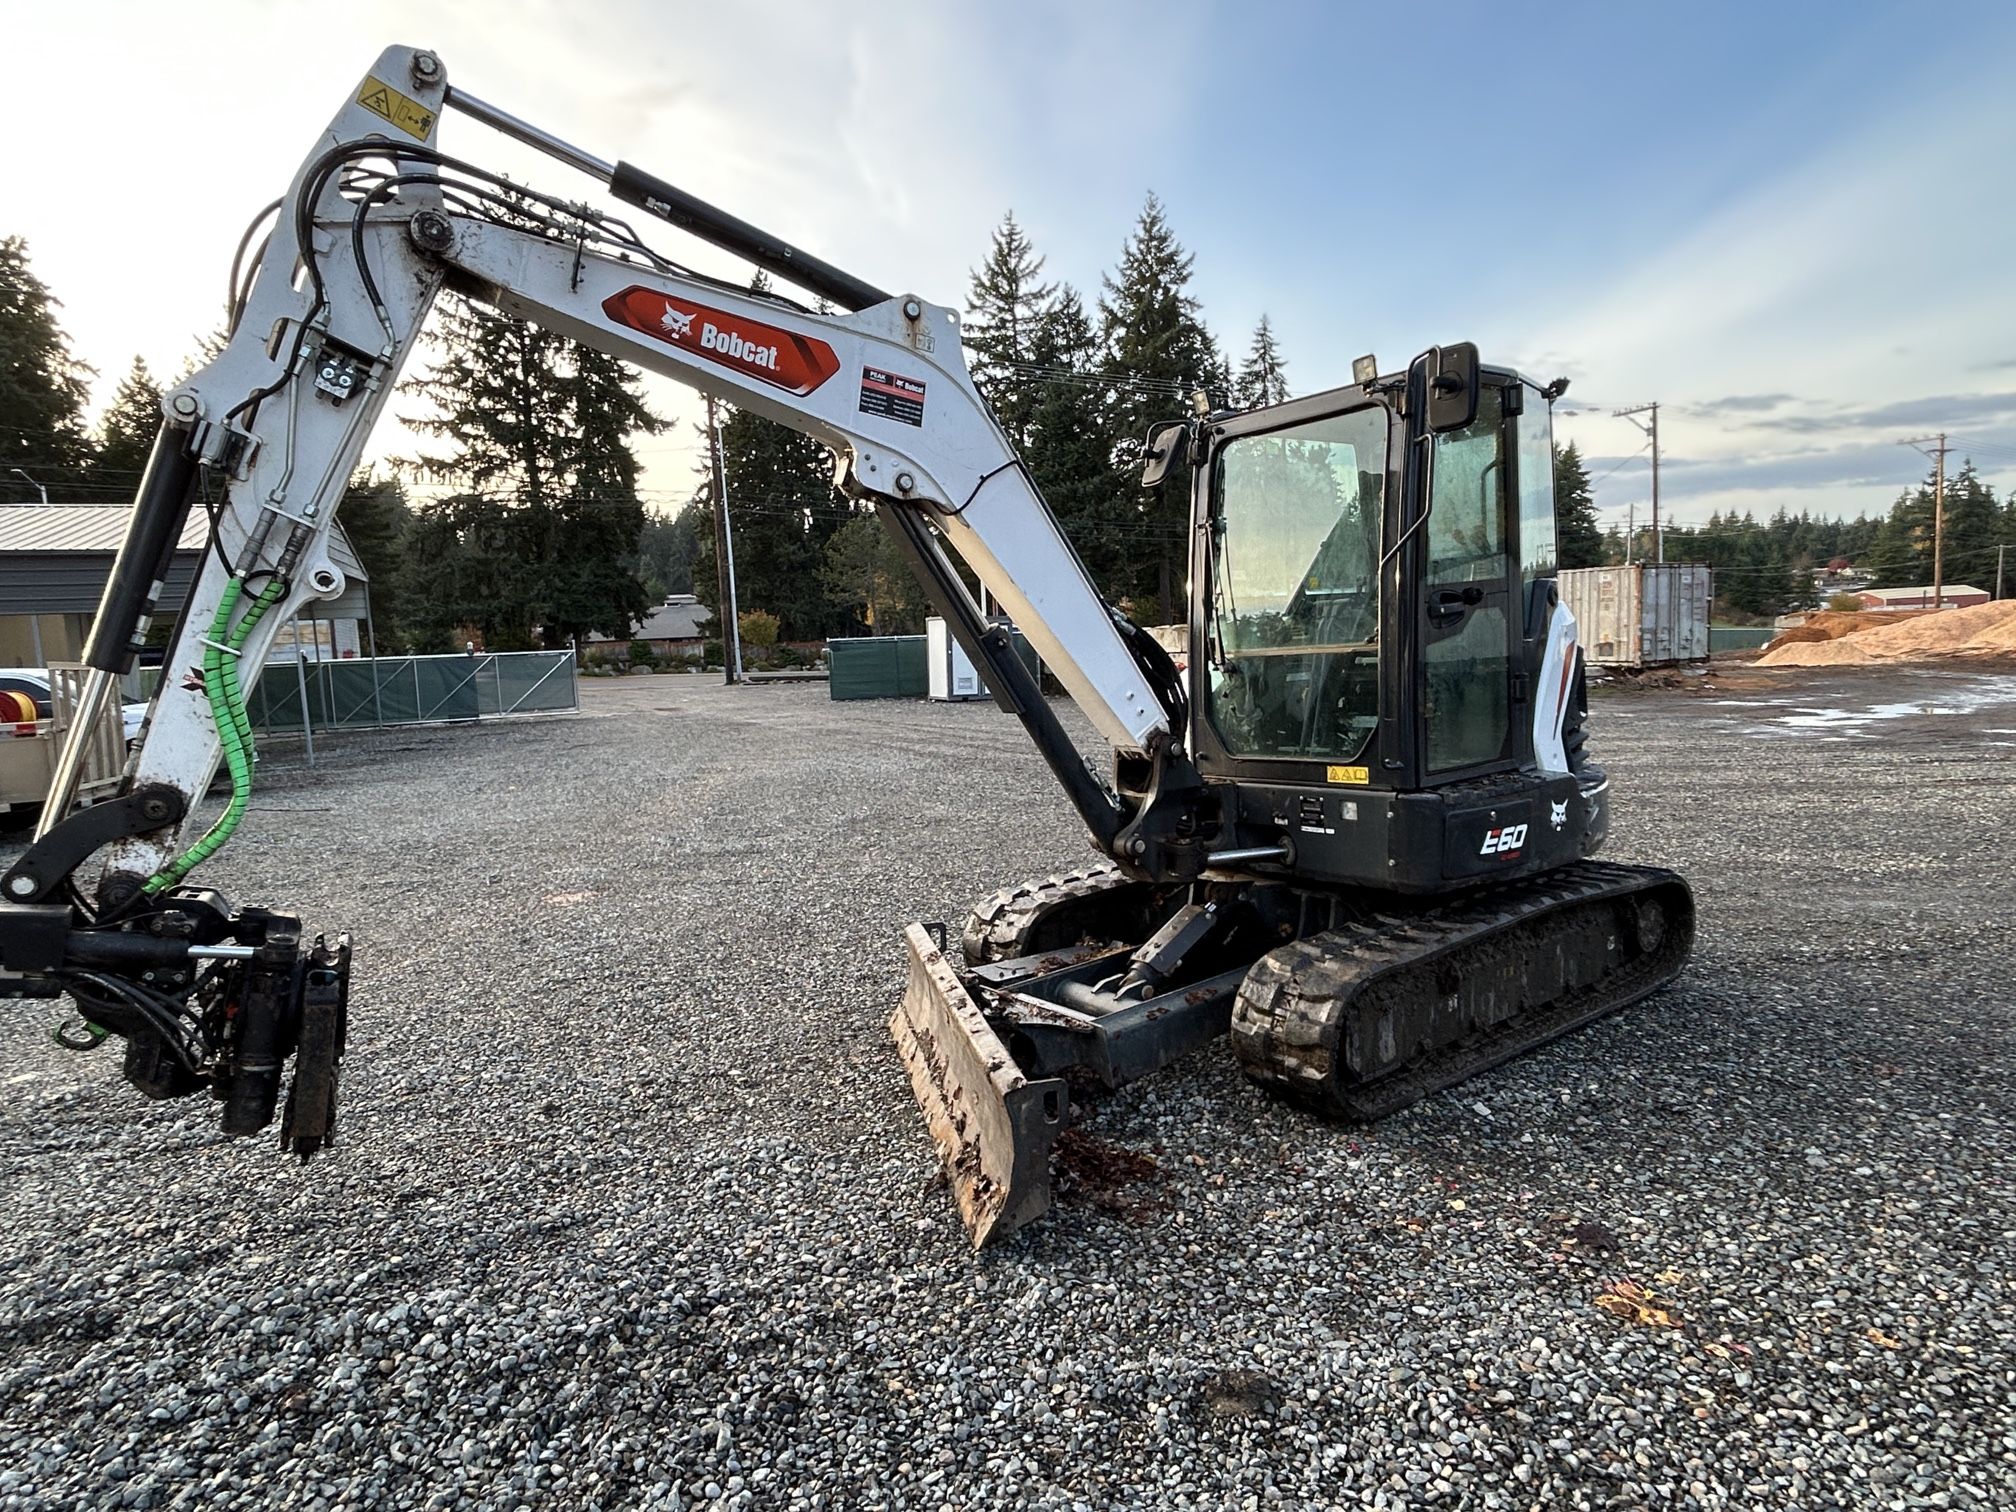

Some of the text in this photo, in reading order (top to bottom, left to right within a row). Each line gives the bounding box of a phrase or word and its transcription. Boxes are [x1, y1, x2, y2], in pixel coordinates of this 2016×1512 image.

[700, 322, 778, 370] Bobcat
[870, 370, 887, 381] PEAK
[904, 381, 924, 394] Bobcat
[1479, 823, 1528, 855] E60
